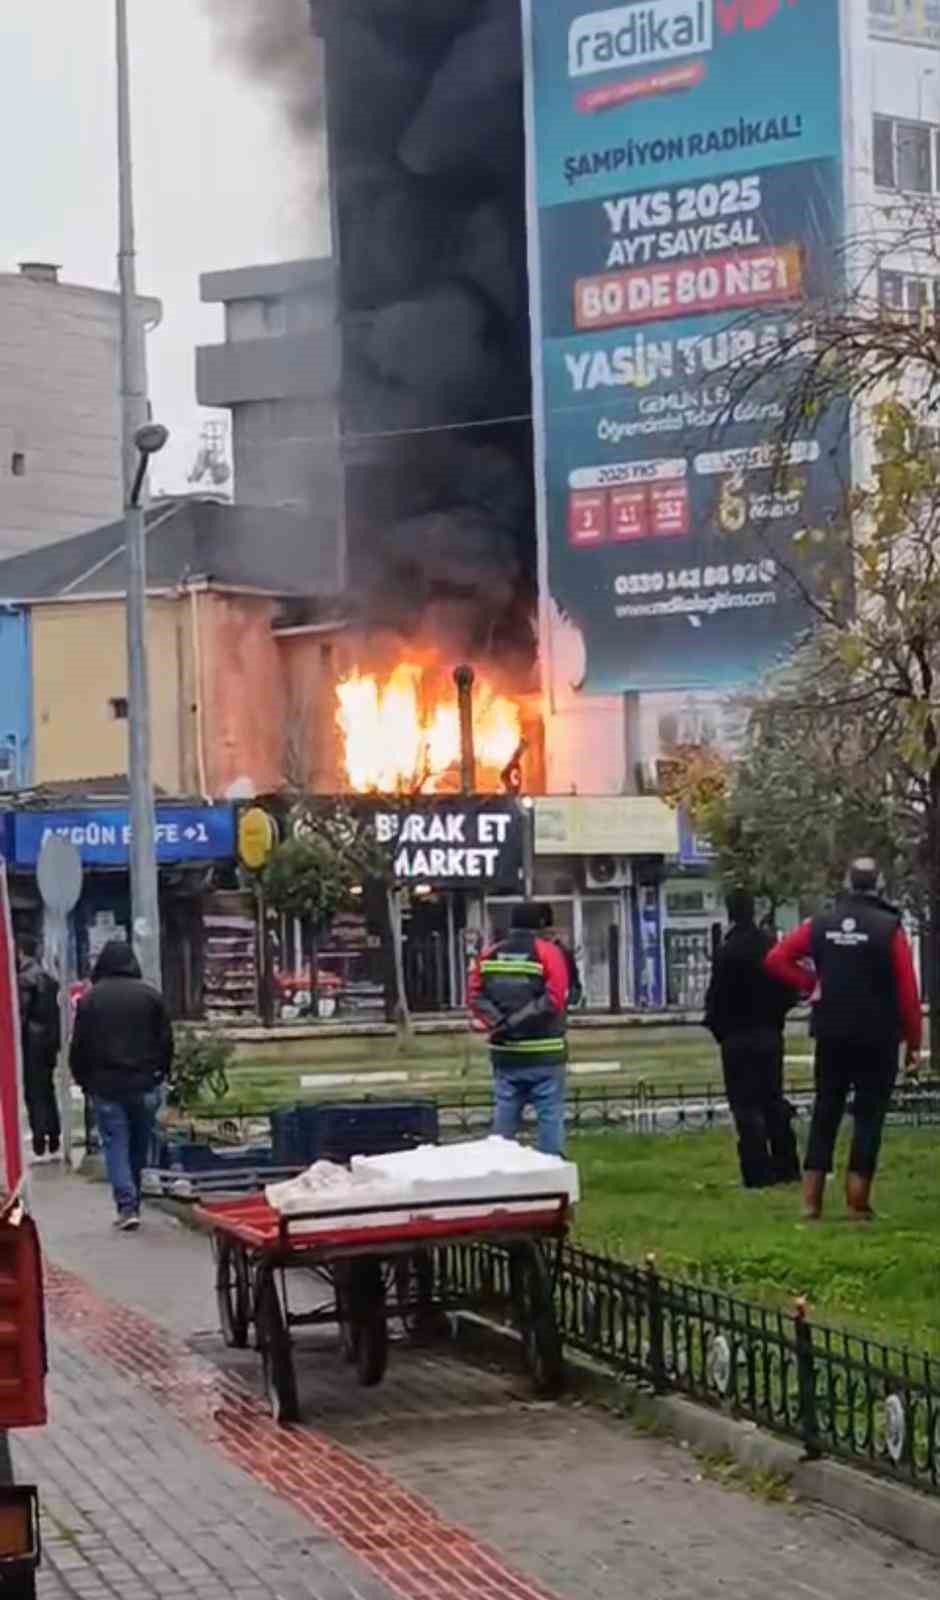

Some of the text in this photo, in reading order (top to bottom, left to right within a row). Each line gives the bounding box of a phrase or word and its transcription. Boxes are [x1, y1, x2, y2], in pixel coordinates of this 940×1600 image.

[576, 1, 706, 68] radikal
[563, 115, 802, 185] ŞAMPİYON RADİKAL!
[603, 176, 762, 232] YKS 2025
[606, 219, 760, 267] AYT SAYISAL
[628, 274, 671, 310] DE
[676, 267, 719, 303] 80
[564, 333, 672, 391] YASİN
[122, 823, 179, 844] BFE
[375, 813, 466, 842] BURAK
[477, 813, 512, 842] ET
